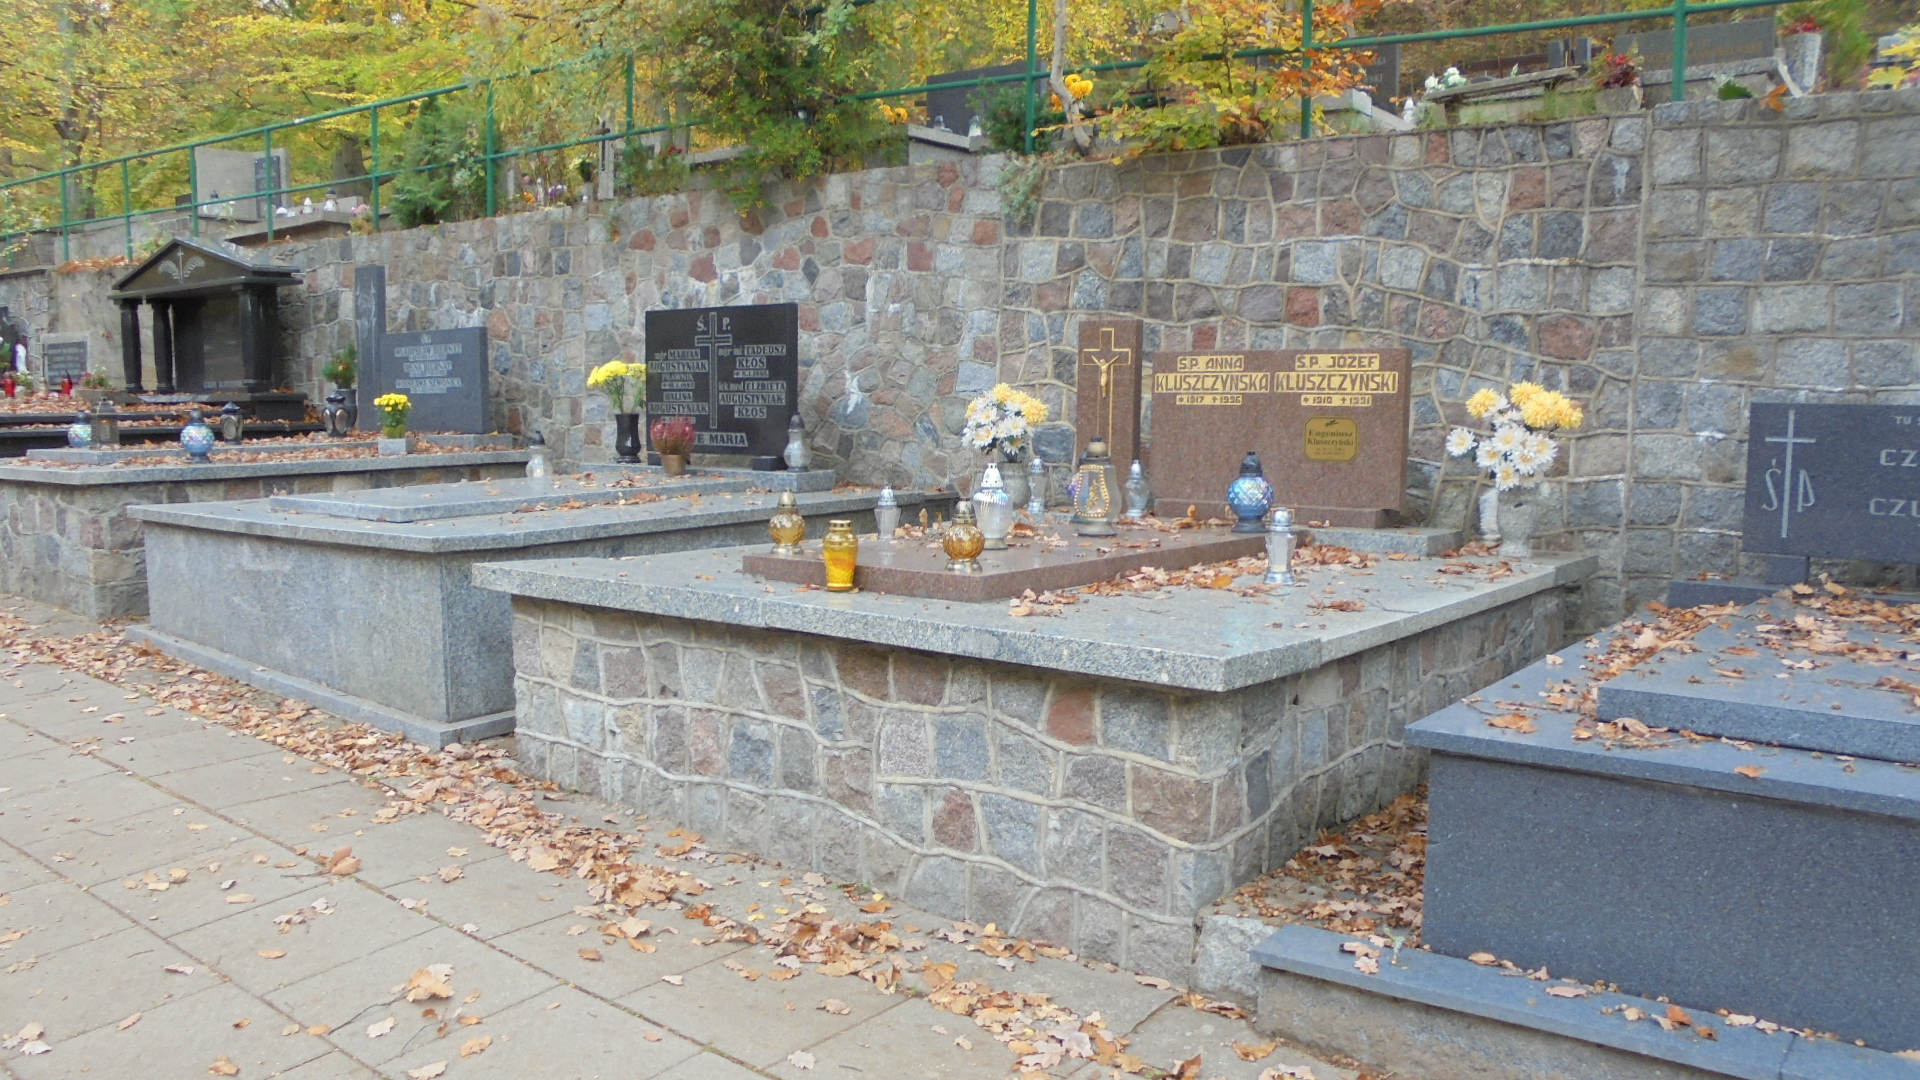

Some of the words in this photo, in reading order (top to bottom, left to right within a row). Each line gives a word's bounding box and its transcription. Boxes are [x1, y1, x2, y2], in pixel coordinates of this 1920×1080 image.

[669, 350, 700, 359] MARIAN
[745, 345, 786, 355] TADEUSZ
[649, 361, 708, 372] AUGUSTYNIAK
[738, 357, 765, 368] KŁOS
[1205, 356, 1243, 370] ANNA
[649, 403, 708, 414] AUGUSTYNIAK
[709, 433, 745, 446] MARIA
